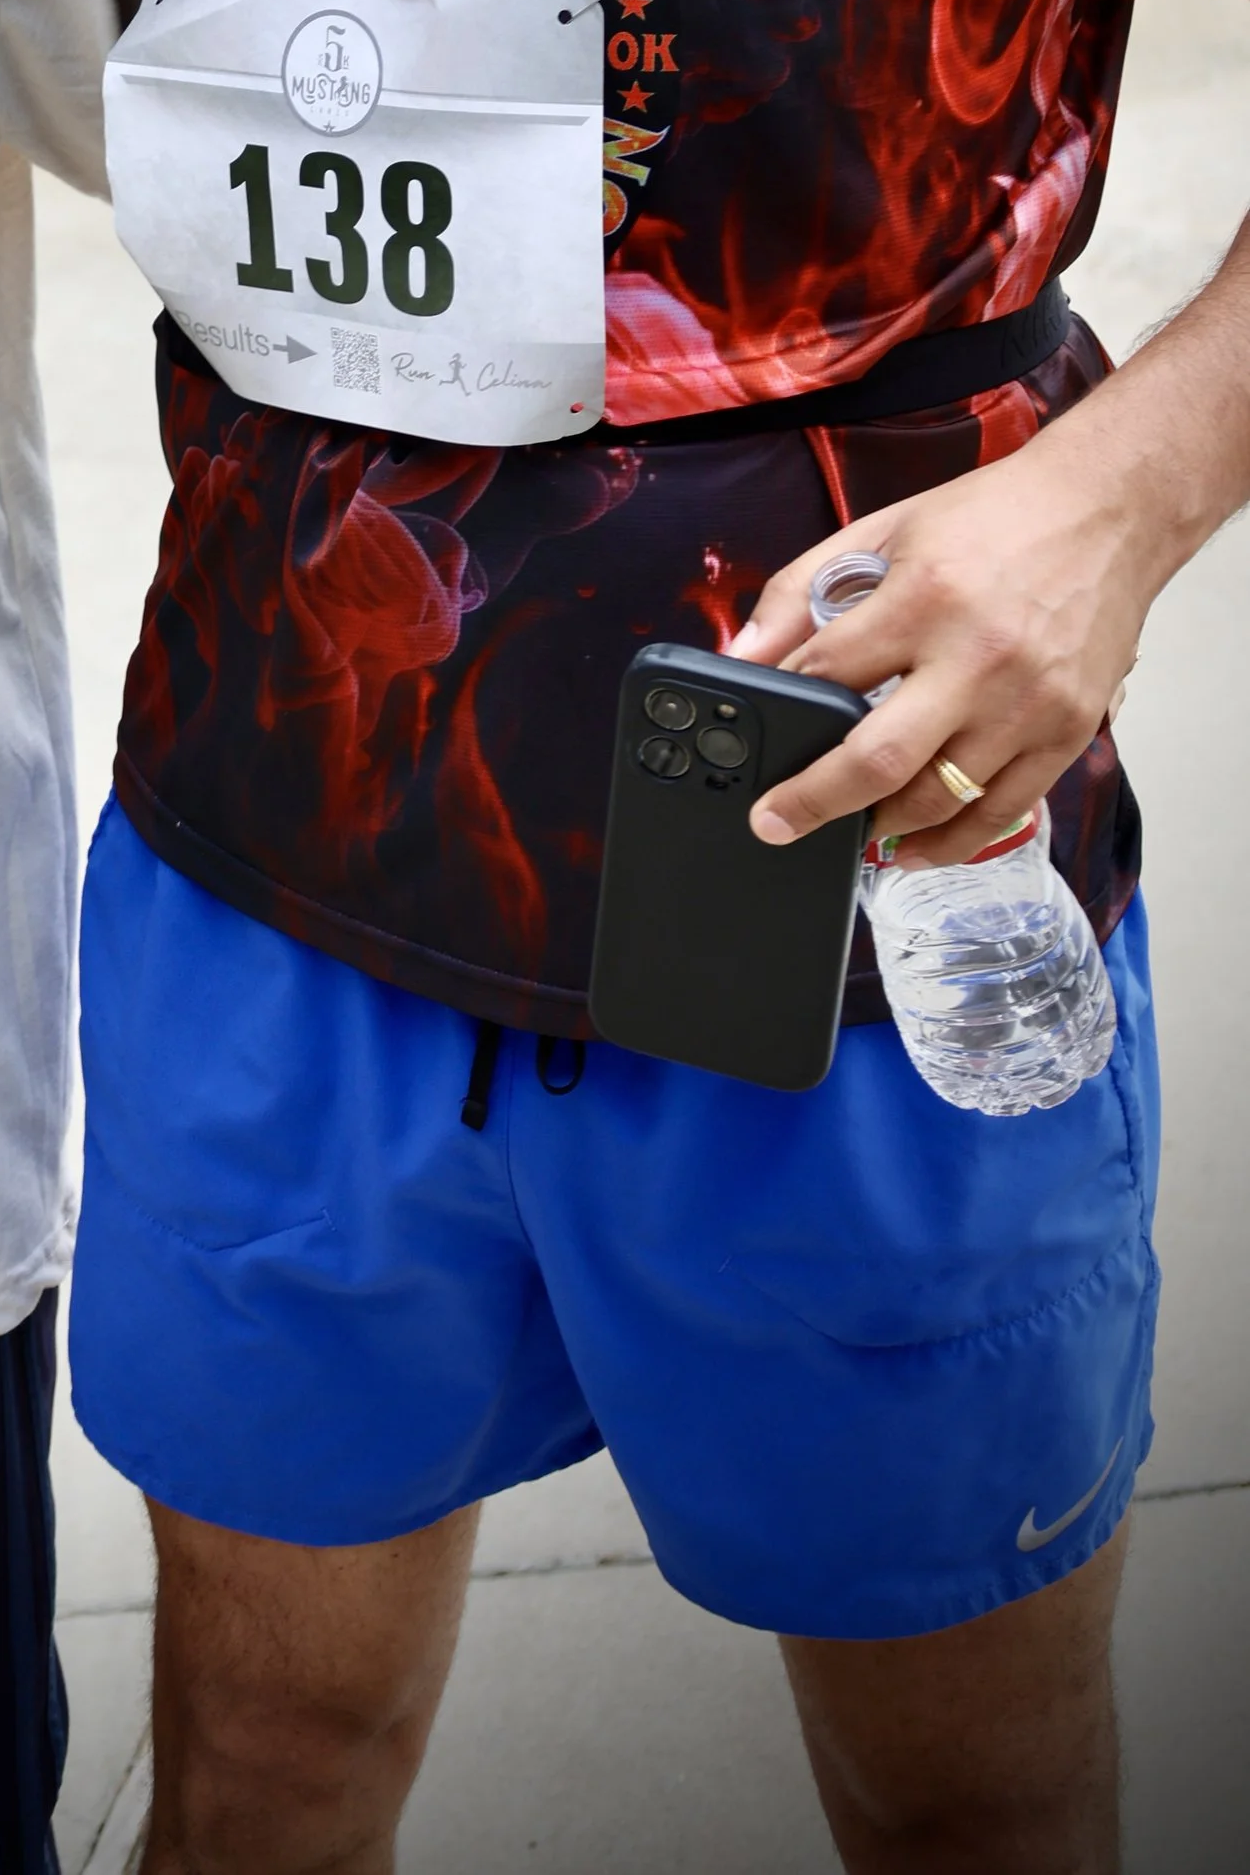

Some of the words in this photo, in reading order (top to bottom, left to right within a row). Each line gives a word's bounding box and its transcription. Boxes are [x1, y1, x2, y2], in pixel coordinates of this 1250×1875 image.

[607, 33, 679, 72] OK
[291, 73, 370, 107] MUSTANG
[229, 143, 455, 316] 138
[391, 352, 436, 382] Run
